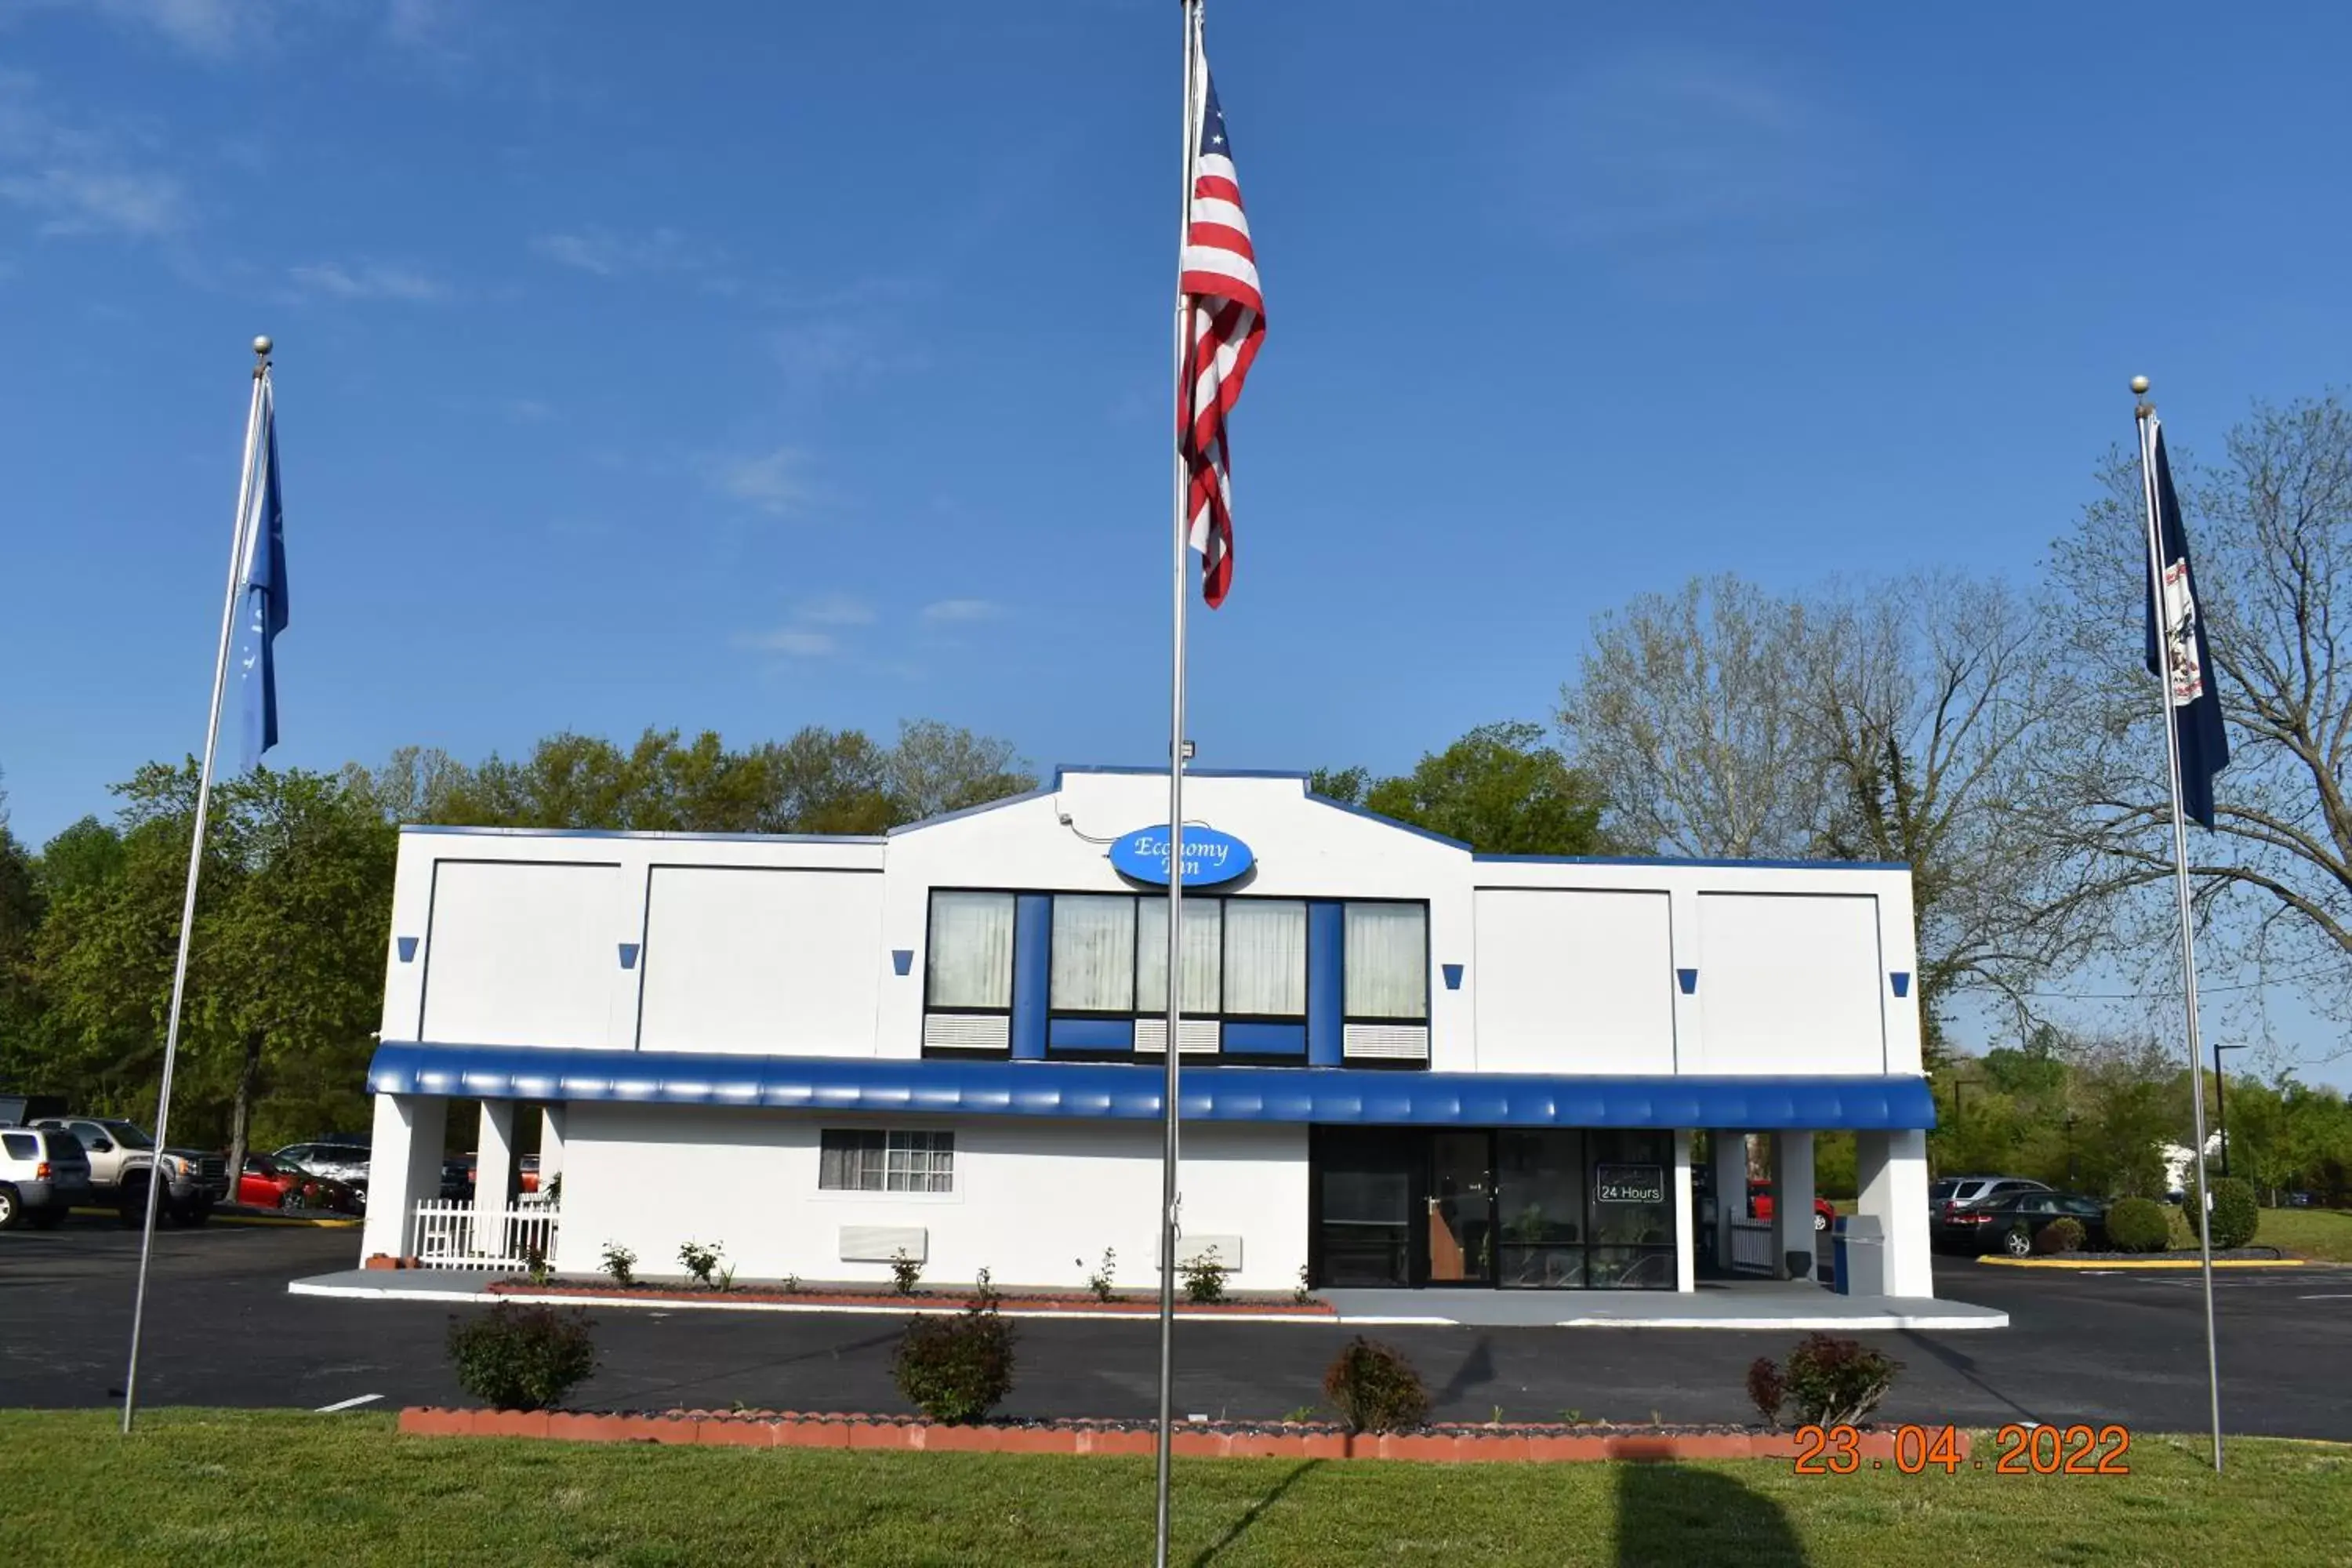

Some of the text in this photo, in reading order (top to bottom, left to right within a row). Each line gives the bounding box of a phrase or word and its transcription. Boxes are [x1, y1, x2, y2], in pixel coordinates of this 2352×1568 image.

[1134, 837, 1229, 866] Ecoomy
[1161, 857, 1200, 875] In
[1602, 1185, 1660, 1199] 24 Hours
